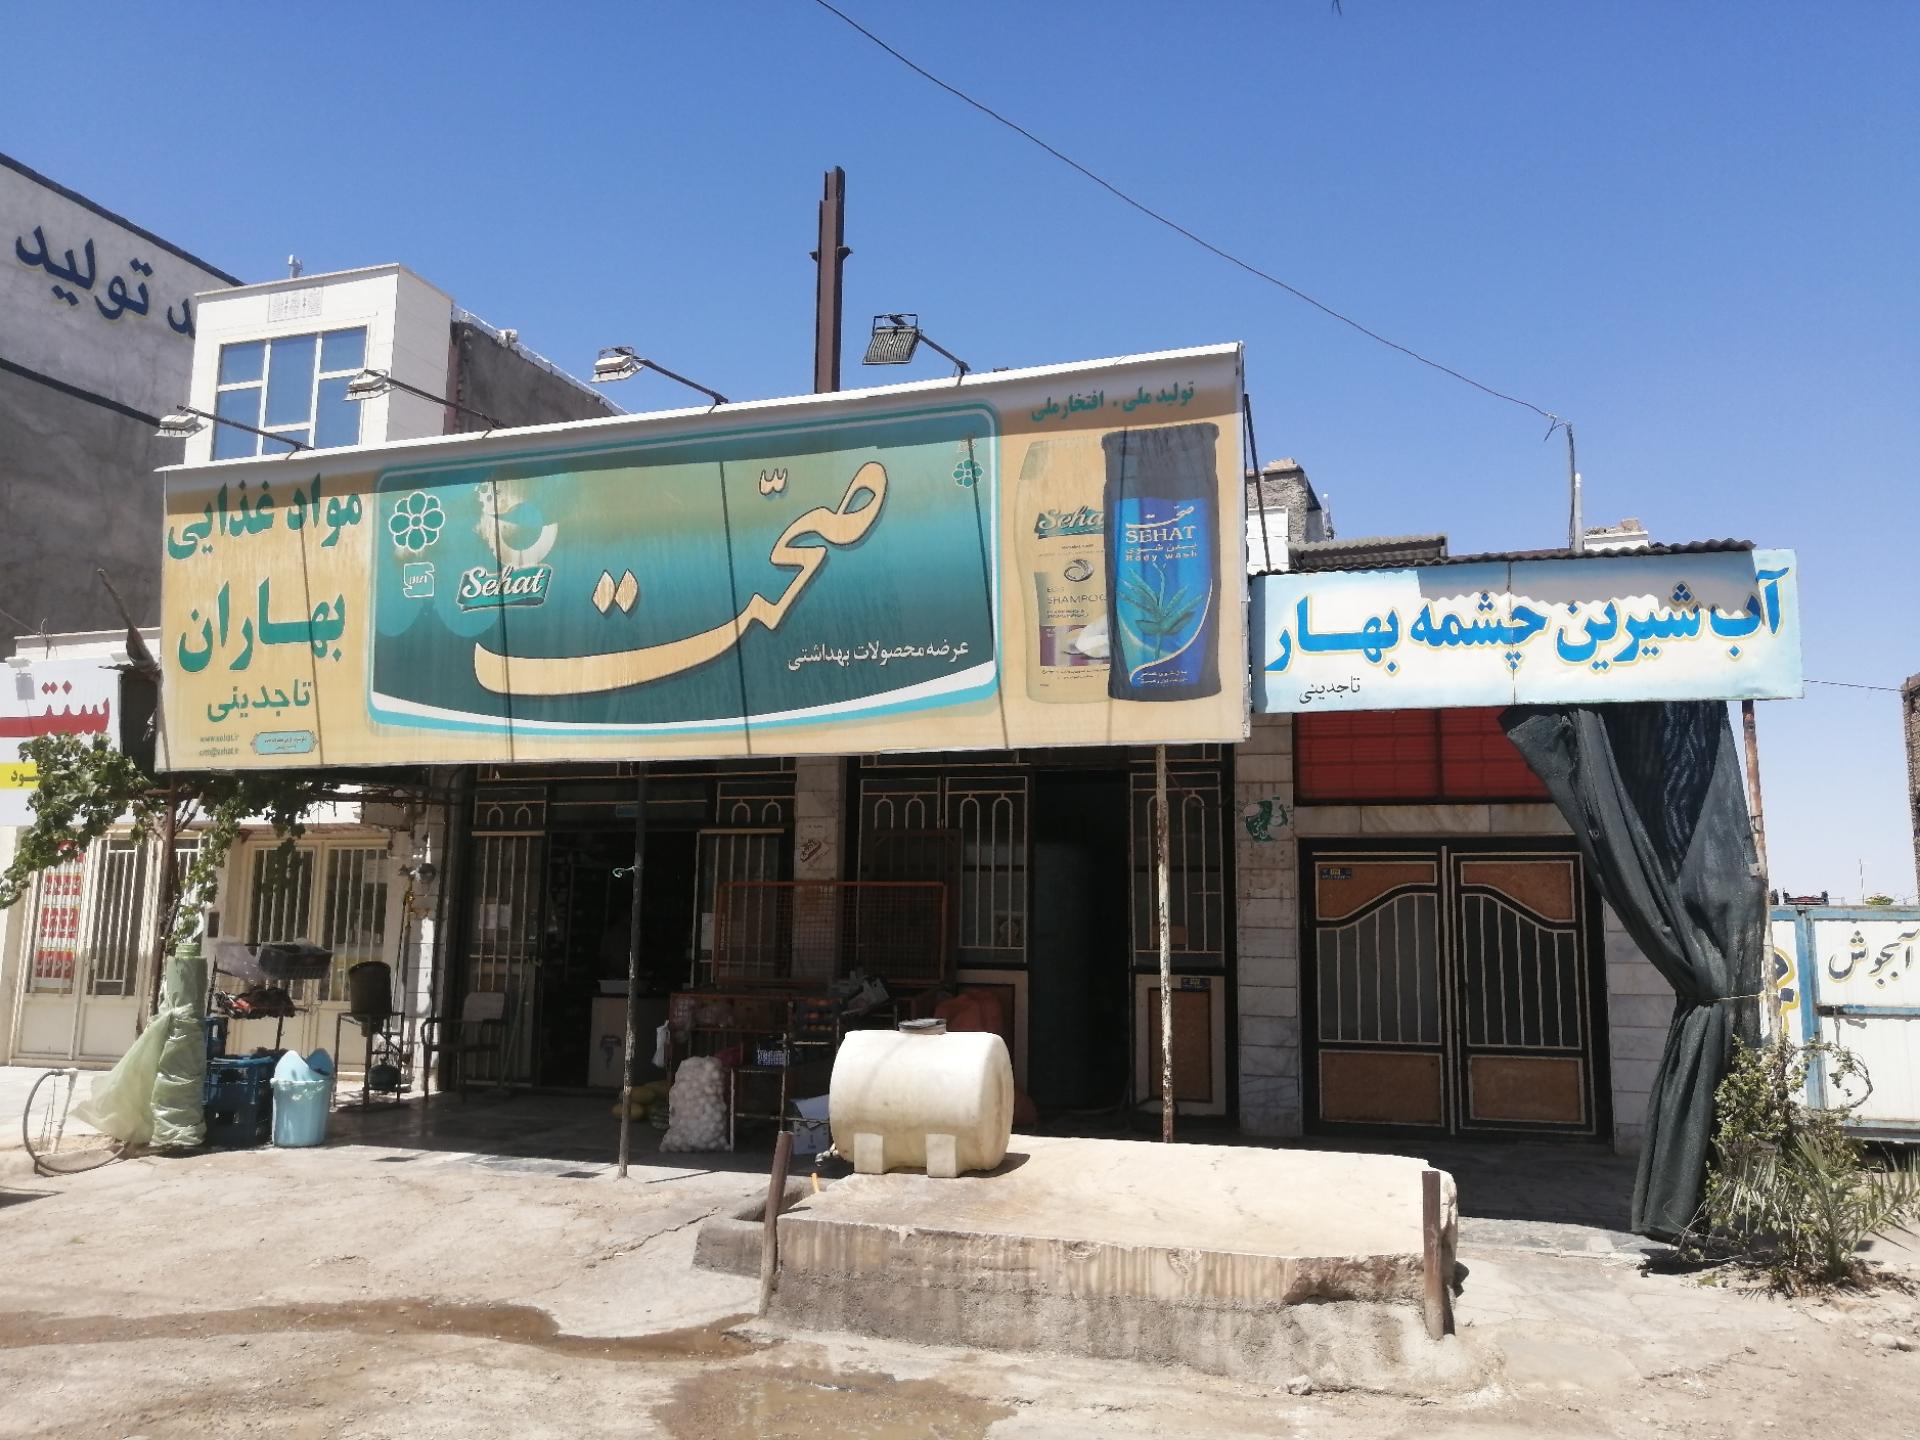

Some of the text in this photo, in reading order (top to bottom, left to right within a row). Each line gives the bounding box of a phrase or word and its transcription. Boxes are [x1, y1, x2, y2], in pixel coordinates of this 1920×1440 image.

[15, 225, 154, 320] تولید
[1060, 390, 1105, 419] افتخار
[1122, 385, 1152, 412] ملی
[1156, 381, 1195, 406] تولید
[1032, 397, 1060, 422] ملی
[167, 473, 363, 560] مواد غذایی
[1038, 505, 1104, 531] Seha
[1125, 525, 1197, 543] SEHAT
[461, 564, 546, 598] Sehat
[177, 577, 347, 673] بهاران
[1265, 567, 1790, 674] آب شیرین چشمه بهار
[788, 638, 969, 671] عرضه محصولات بهداشتی
[207, 678, 312, 723] تاجدینی
[1299, 675, 1361, 704] تاجدینی
